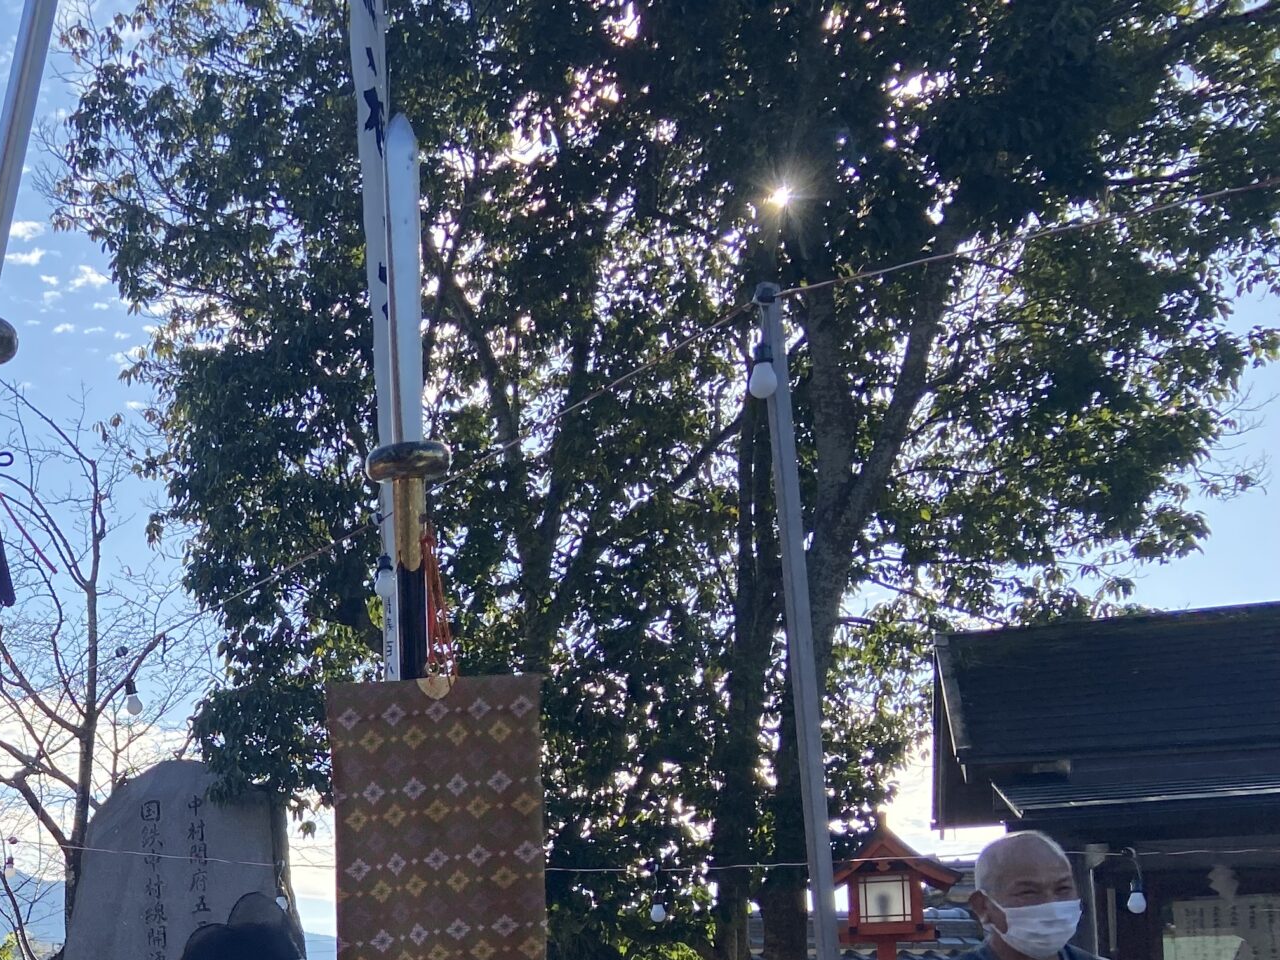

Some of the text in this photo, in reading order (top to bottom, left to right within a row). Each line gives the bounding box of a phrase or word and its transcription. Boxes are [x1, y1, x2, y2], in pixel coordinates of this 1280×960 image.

[186, 794, 211, 927] 中村開府五
